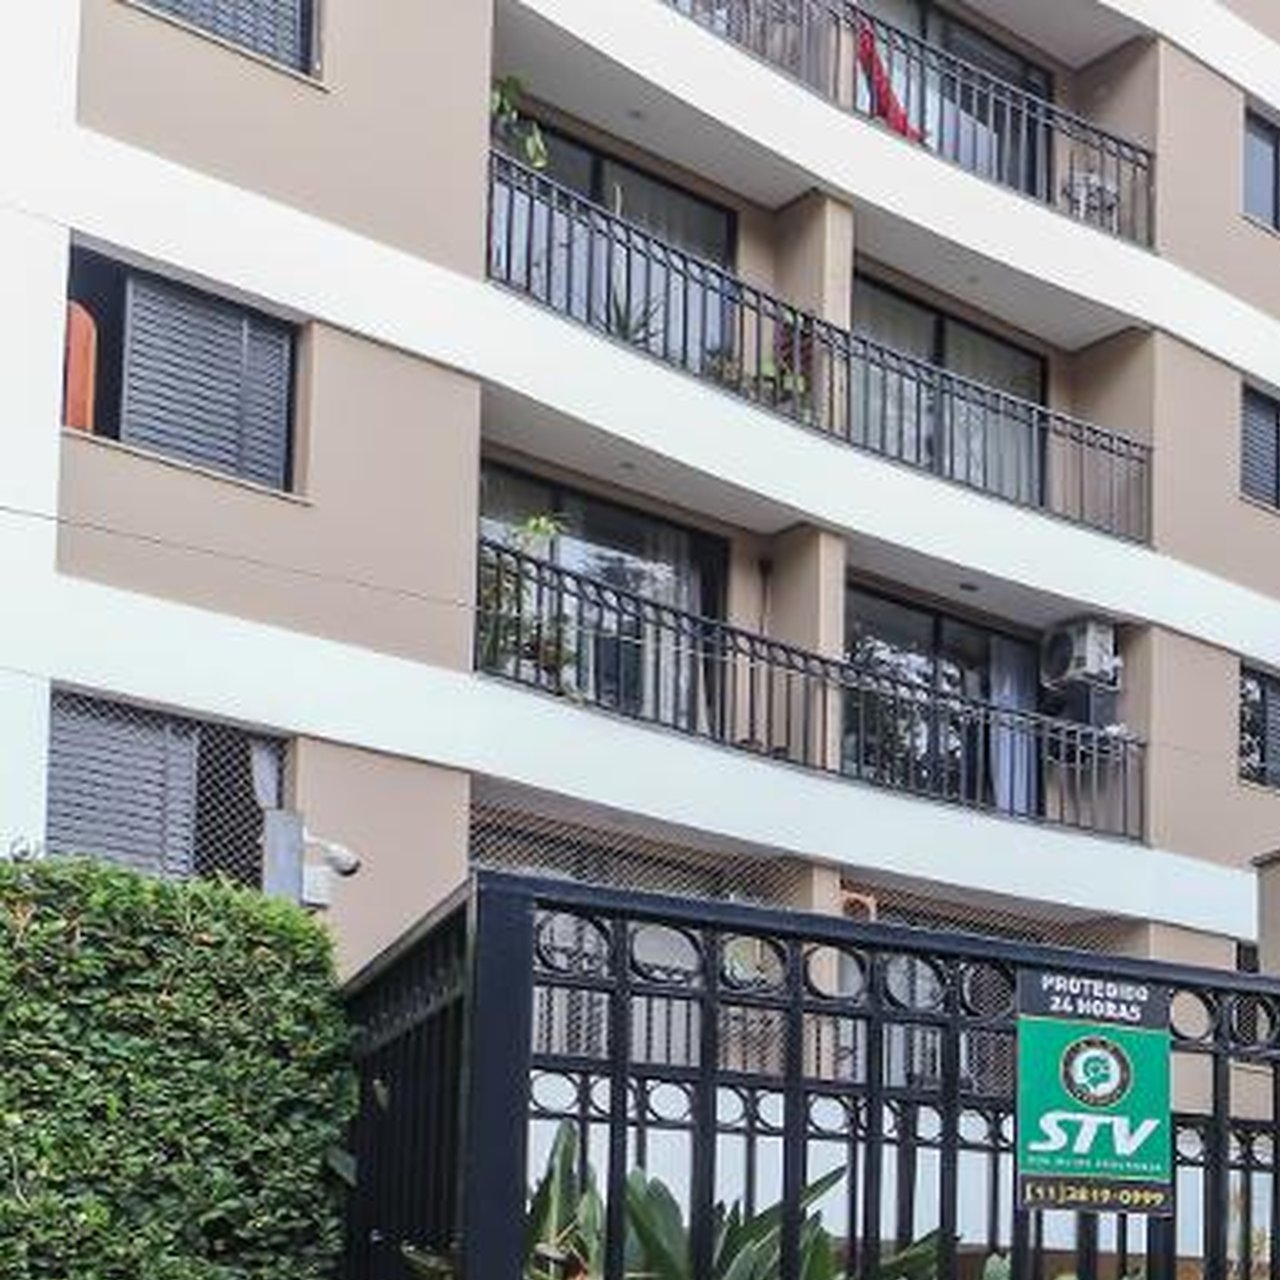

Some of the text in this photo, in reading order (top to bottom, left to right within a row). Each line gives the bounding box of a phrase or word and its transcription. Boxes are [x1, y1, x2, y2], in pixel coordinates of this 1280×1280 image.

[1050, 995, 1142, 1021] 24 HORAS
[1027, 1109, 1161, 1157] STV
